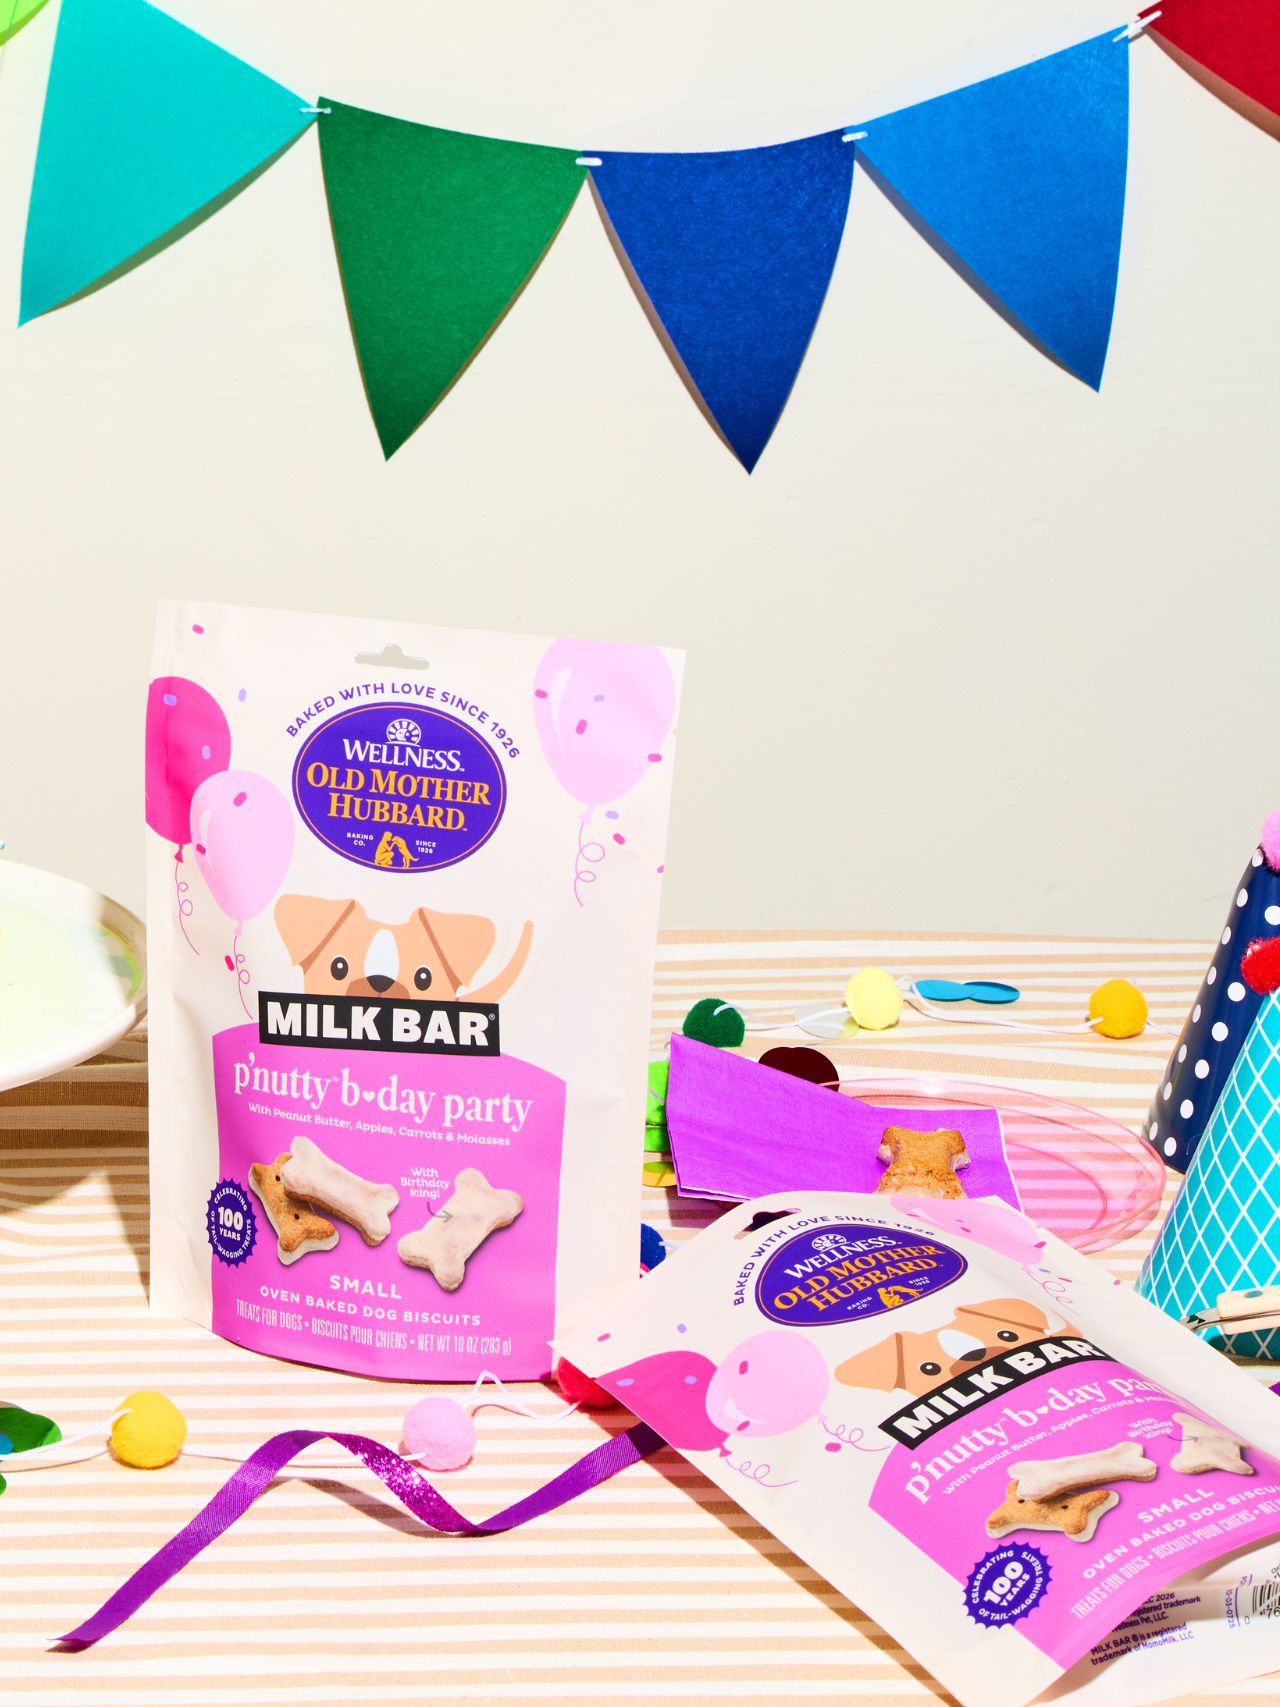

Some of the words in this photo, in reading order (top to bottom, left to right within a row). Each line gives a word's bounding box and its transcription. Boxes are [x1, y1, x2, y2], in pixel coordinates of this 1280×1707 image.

[286, 696, 336, 737] BAKED
[339, 682, 385, 700] WITH
[391, 682, 436, 699] LOVE
[440, 691, 489, 724] SINCE
[491, 722, 520, 759] 1926
[306, 762, 365, 791] OLD
[370, 768, 491, 806] MOTHER
[346, 832, 374, 841] BAKING
[415, 839, 437, 848] SINCE
[267, 1001, 381, 1041] MILK
[248, 1102, 272, 1117] With
[273, 1109, 313, 1123] Peanut
[314, 1114, 353, 1131] Butter,
[355, 1120, 397, 1137] Apples,
[399, 1127, 443, 1141] Carrots
[445, 1132, 454, 1142] &
[457, 1133, 511, 1145] Molasses
[442, 1092, 534, 1132] party
[400, 1176, 450, 1190] Birthday
[410, 1167, 439, 1178] With
[214, 1187, 248, 1211] CELEBRATING
[410, 1187, 441, 1200] Icing!
[210, 1210, 216, 1223] OF
[242, 1219, 252, 1250] TREATS
[218, 1206, 243, 1231] 100
[219, 1227, 241, 1241] YEARS
[734, 1262, 755, 1306] BAKED
[752, 1230, 787, 1259] WITH
[788, 1215, 831, 1231] LOVE
[835, 1215, 888, 1225] SINCE
[893, 1223, 935, 1237] 1926
[774, 1275, 830, 1310] OLD
[825, 1245, 945, 1280] MOTHER
[329, 1274, 402, 1300] SMALL
[847, 1296, 873, 1311] BAKING
[260, 1285, 300, 1305] OVEN
[305, 1295, 357, 1315] BAKED
[363, 1306, 397, 1321] DOG
[403, 1311, 481, 1327] BISCUITS
[236, 1298, 261, 1324] TREATS
[261, 1306, 278, 1327] FOR
[279, 1311, 302, 1332] DOGS
[311, 1320, 349, 1340] BISCUITS
[350, 1325, 373, 1347] POUR
[375, 1329, 407, 1350] CHIENS
[417, 1333, 435, 1352] NET
[436, 1335, 452, 1353] WT
[453, 1336, 465, 1354] 10
[466, 1336, 479, 1354] OZ
[480, 1337, 500, 1356] (283
[502, 1339, 512, 1356] g)
[893, 1365, 1014, 1439] MILK
[1126, 1421, 1174, 1438] Birthday
[1128, 1418, 1158, 1429] With
[942, 1473, 971, 1496] With
[970, 1449, 1012, 1474] Peanut
[1011, 1430, 1052, 1451] Butter,
[1051, 1412, 1093, 1433] Apples,
[1091, 1399, 1135, 1415] Carrots
[1137, 1488, 1216, 1523] SMALL
[1083, 1545, 1129, 1580] OVEN
[1129, 1518, 1187, 1547] BAKED
[1188, 1503, 1226, 1522] DOG
[972, 1550, 1014, 1604] CELEBRATING
[983, 1561, 1024, 1604] 100
[1070, 1587, 1109, 1620] TREATS
[1100, 1572, 1126, 1592] FOR
[1118, 1555, 1151, 1580] DOGS
[1150, 1533, 1198, 1560] BISCUITS
[1191, 1521, 1223, 1543] POUR
[1217, 1509, 1256, 1533] CHIENS
[978, 1608, 990, 1617] OF
[990, 1577, 1043, 1621] TAIL-WAGGING
[1021, 1551, 1044, 1576] TREATS
[999, 1572, 1031, 1607] YEARS
[1156, 1592, 1175, 1602] 2026
[1163, 1595, 1202, 1610] trademark
[1090, 1643, 1114, 1656] MILK
[1113, 1635, 1131, 1649] BAR
[1151, 1622, 1187, 1639] registered
[1090, 1645, 1133, 1666] trademark
[1133, 1641, 1142, 1652] of
[1180, 1630, 1195, 1641] LLC
